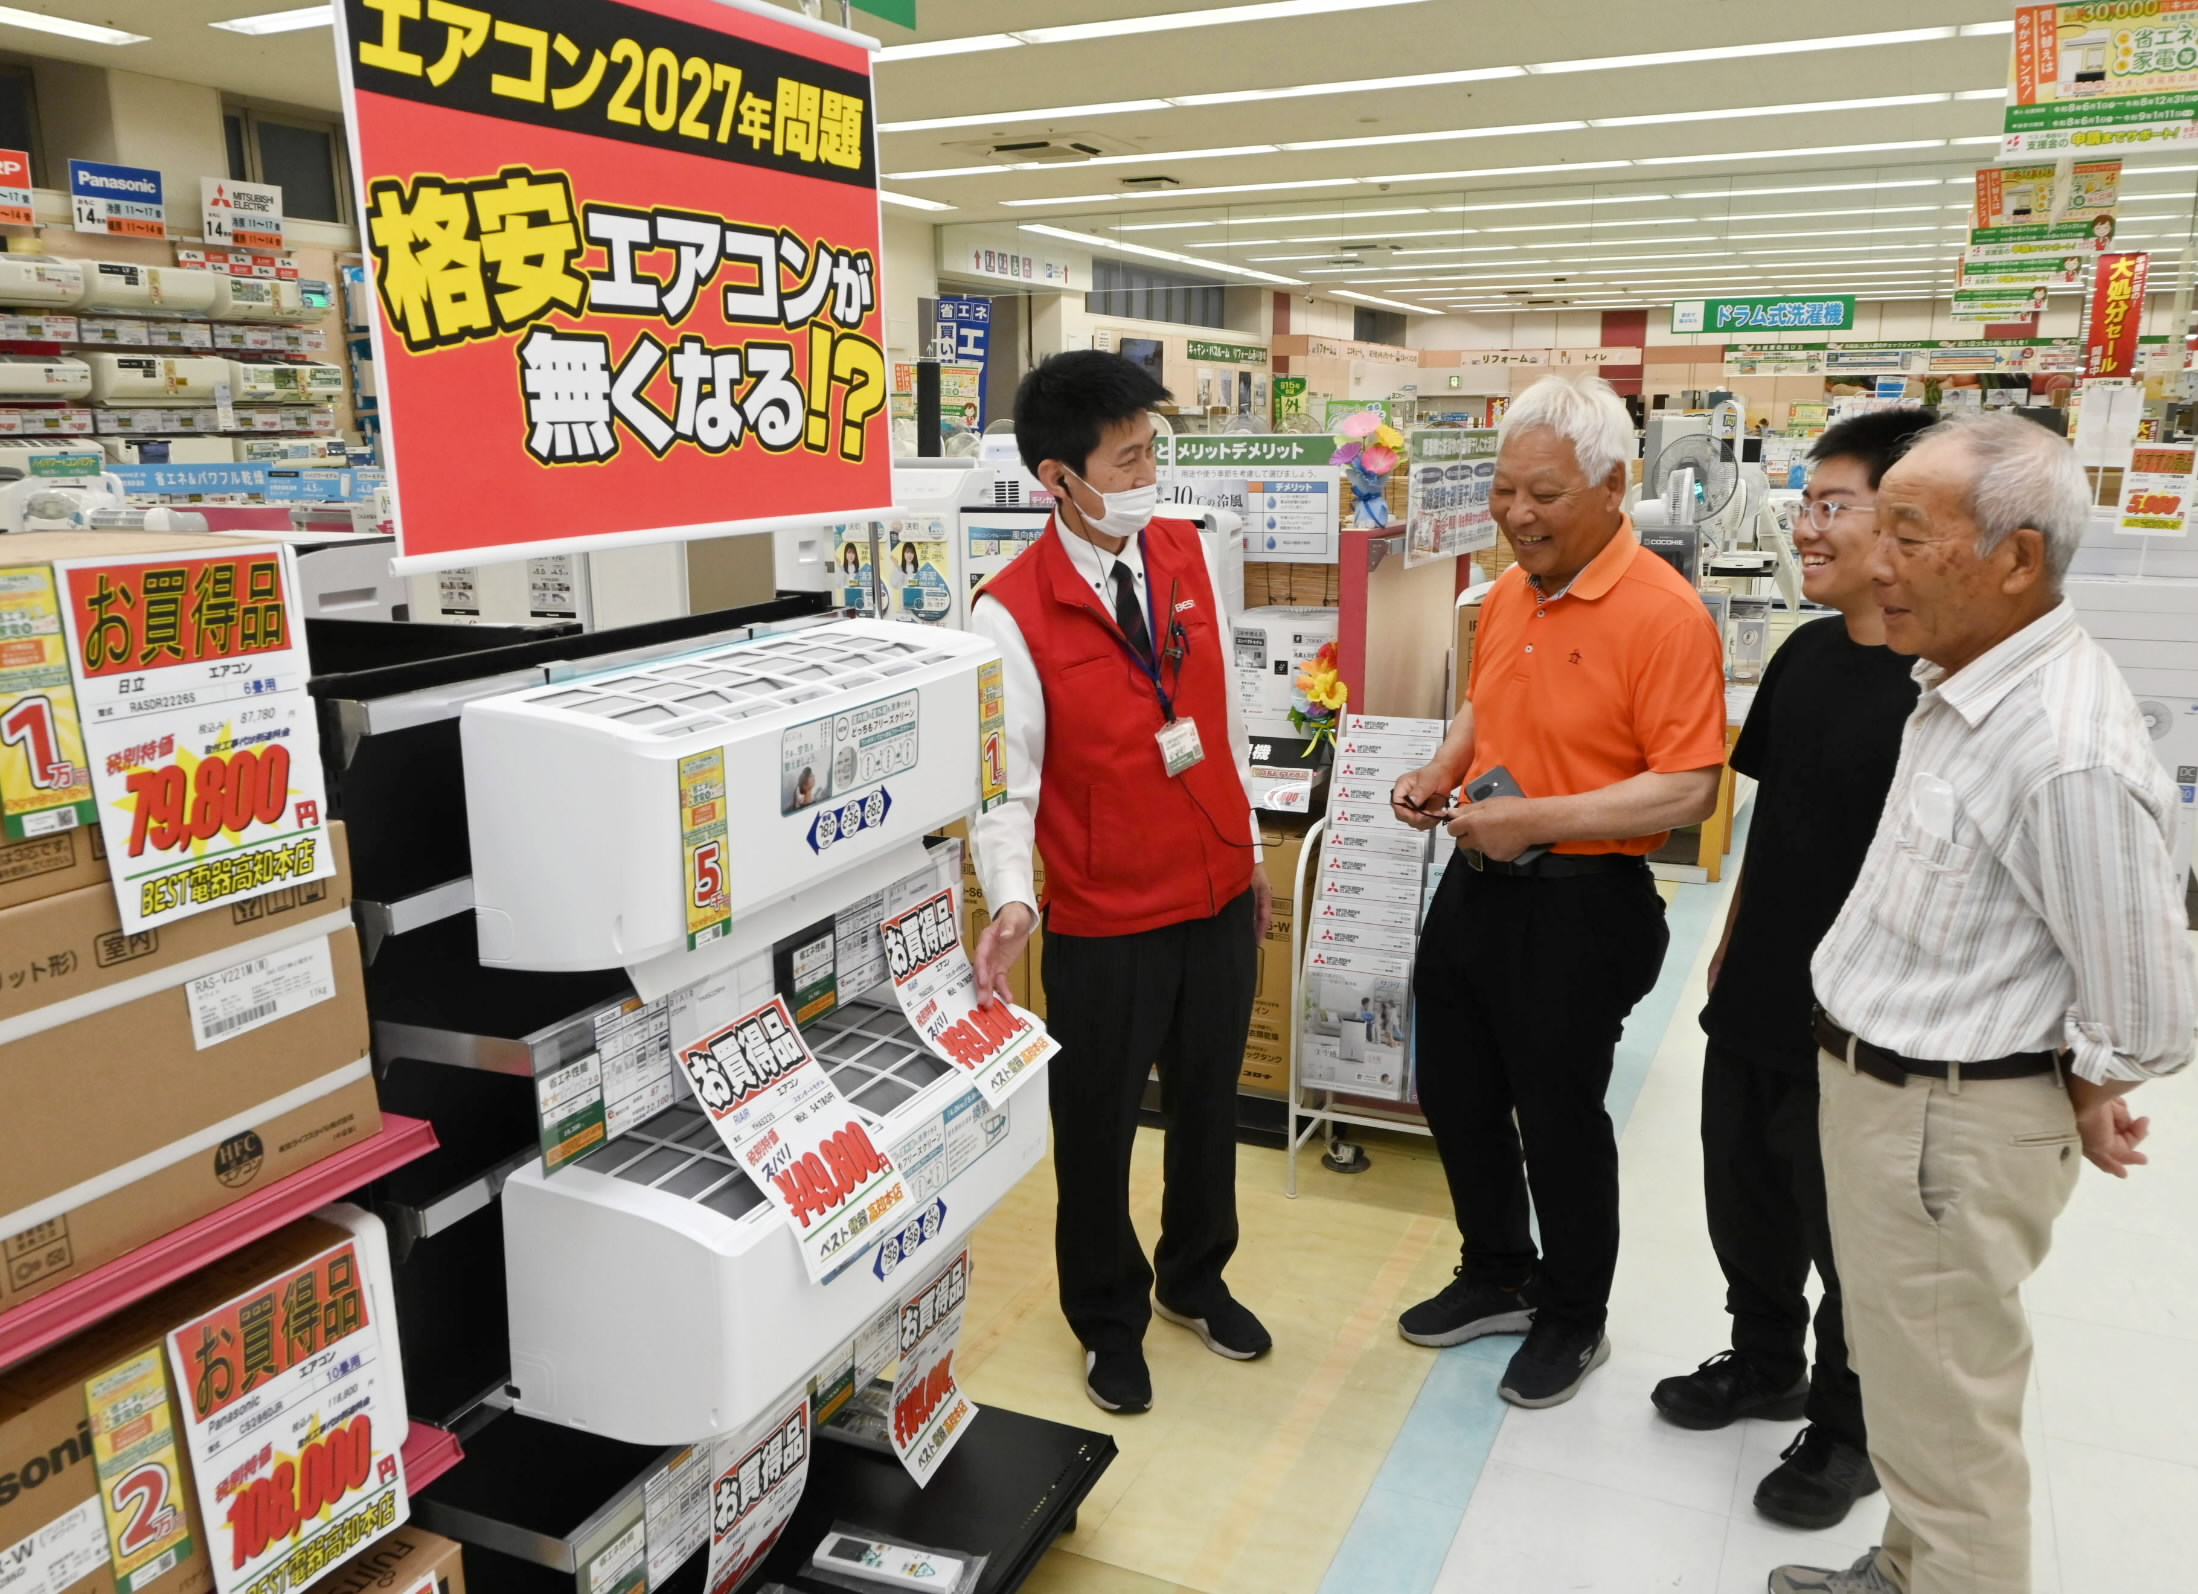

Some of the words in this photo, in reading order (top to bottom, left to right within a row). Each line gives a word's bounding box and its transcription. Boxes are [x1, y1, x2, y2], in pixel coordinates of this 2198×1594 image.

[2040, 9, 2054, 73] 買い替えは
[2134, 25, 2193, 49] 省エネ
[2018, 15, 2032, 99] 今がチャンス!
[359, 0, 863, 170] エアコン2027年問題
[77, 169, 157, 194] Panasonic
[233, 191, 274, 204] MITSUBISHI
[233, 200, 270, 213] ELECTRIC
[368, 172, 874, 347] 格安エアコンが
[939, 302, 990, 322] 省エネ
[1716, 300, 1845, 328] ドラム式洗濯機
[2099, 256, 2136, 374] 大処分セール
[1482, 353, 1529, 364] リフォーム
[1584, 352, 1608, 361] トイレ
[523, 328, 885, 460] 無くなる!?
[1176, 441, 1305, 461] メリットデメリット
[1181, 468, 1318, 480] 用途や使う季節を考慮して選びましょう。
[1275, 482, 1313, 492] デメリット
[84, 560, 283, 670] お買得品
[1175, 599, 1196, 613] BES
[208, 661, 253, 679] エアコン
[118, 676, 147, 696] 日立
[243, 677, 278, 696] 6畳用
[240, 707, 277, 725] 87,780
[851, 709, 916, 739] どっちもフリーズクリーン
[126, 743, 291, 858] 79,800
[294, 799, 320, 829] 円
[842, 809, 860, 830] 23.6
[865, 799, 883, 820] 28.2
[140, 838, 316, 919] BEST電器高知本店
[103, 932, 151, 962] 室内
[884, 893, 959, 980] お買得品
[935, 958, 950, 973] エアコン
[927, 1010, 949, 1042] ズバリ
[686, 1005, 807, 1112] お買得品
[776, 1077, 800, 1098] エアコン
[218, 1134, 258, 1165] HFC
[760, 1143, 793, 1184] ズバリ
[772, 1120, 881, 1229] ¥49,800
[819, 1181, 905, 1258] ベスト電器高知本店
[903, 1227, 919, 1249] 29.8
[900, 1257, 966, 1353] お買得品
[196, 1253, 361, 1415] お買得品
[298, 1350, 337, 1379] エアコン
[207, 1393, 262, 1436] Panasonic
[714, 1410, 806, 1535] お買得品
[226, 1413, 373, 1571] 108,000
[376, 1453, 398, 1485] 円
